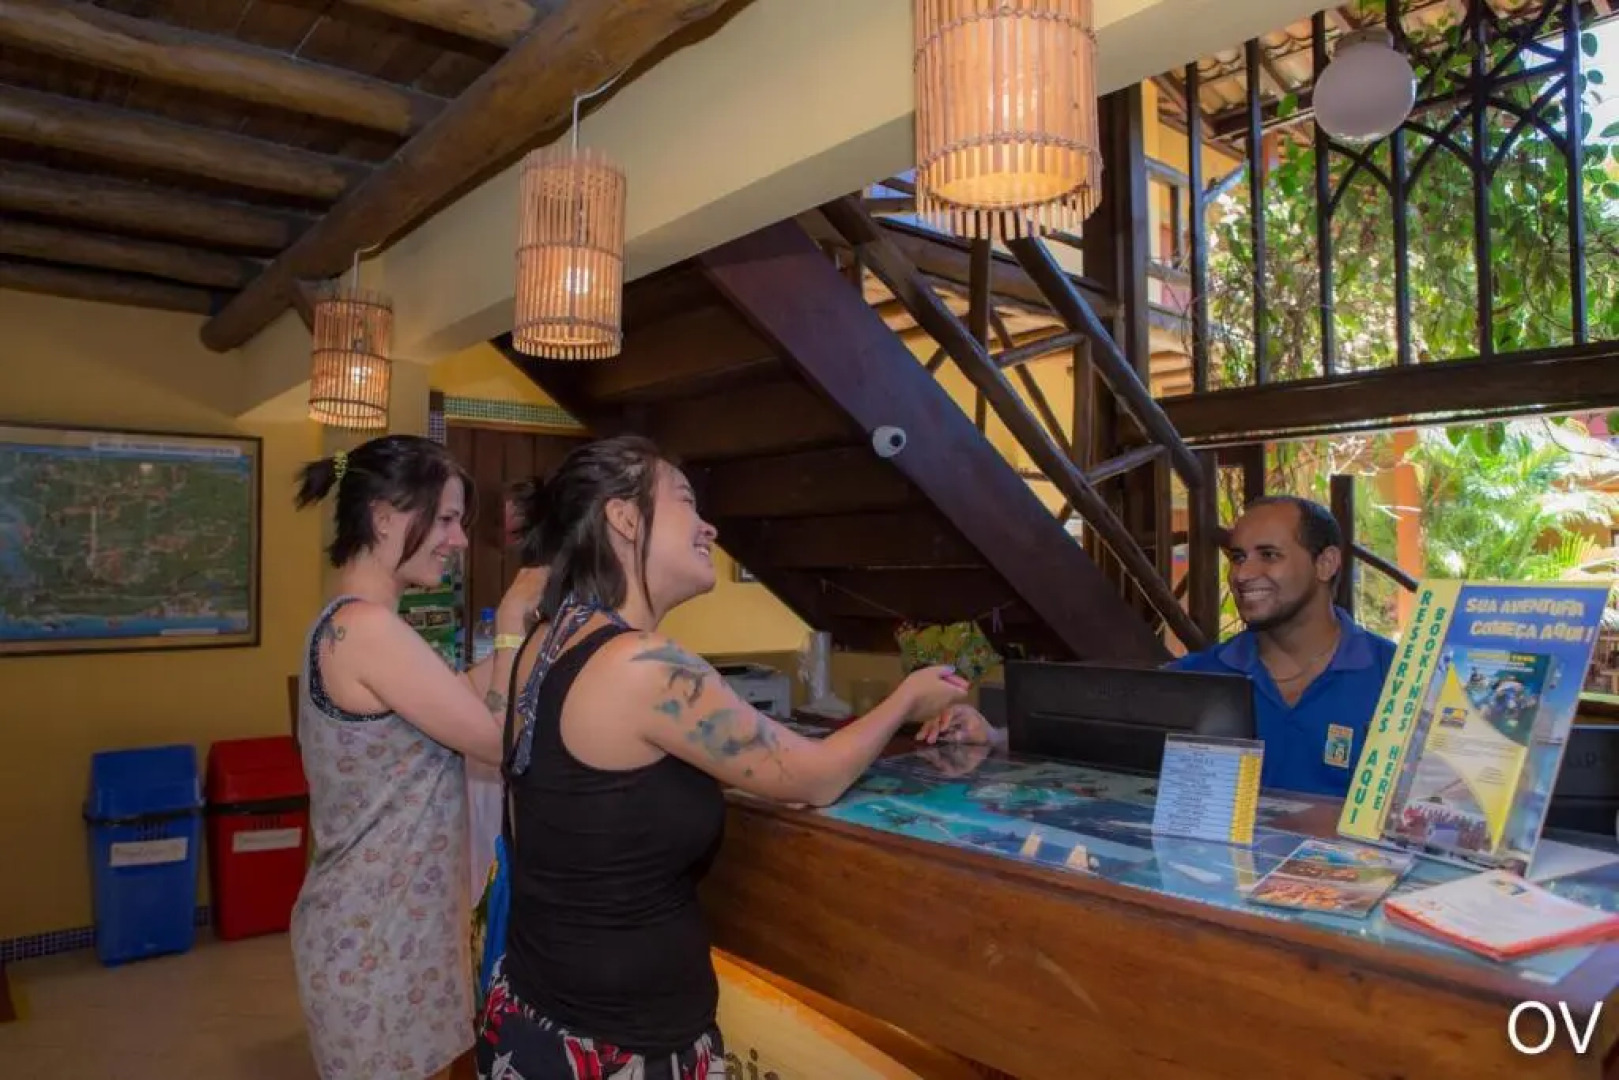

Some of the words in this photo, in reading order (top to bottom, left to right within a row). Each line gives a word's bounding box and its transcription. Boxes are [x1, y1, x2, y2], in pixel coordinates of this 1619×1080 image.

[1379, 589, 1433, 733] RESERVAS
[1398, 606, 1447, 732] BOOKINGS
[1350, 749, 1379, 825] AQUI
[1373, 745, 1400, 810] HERE
